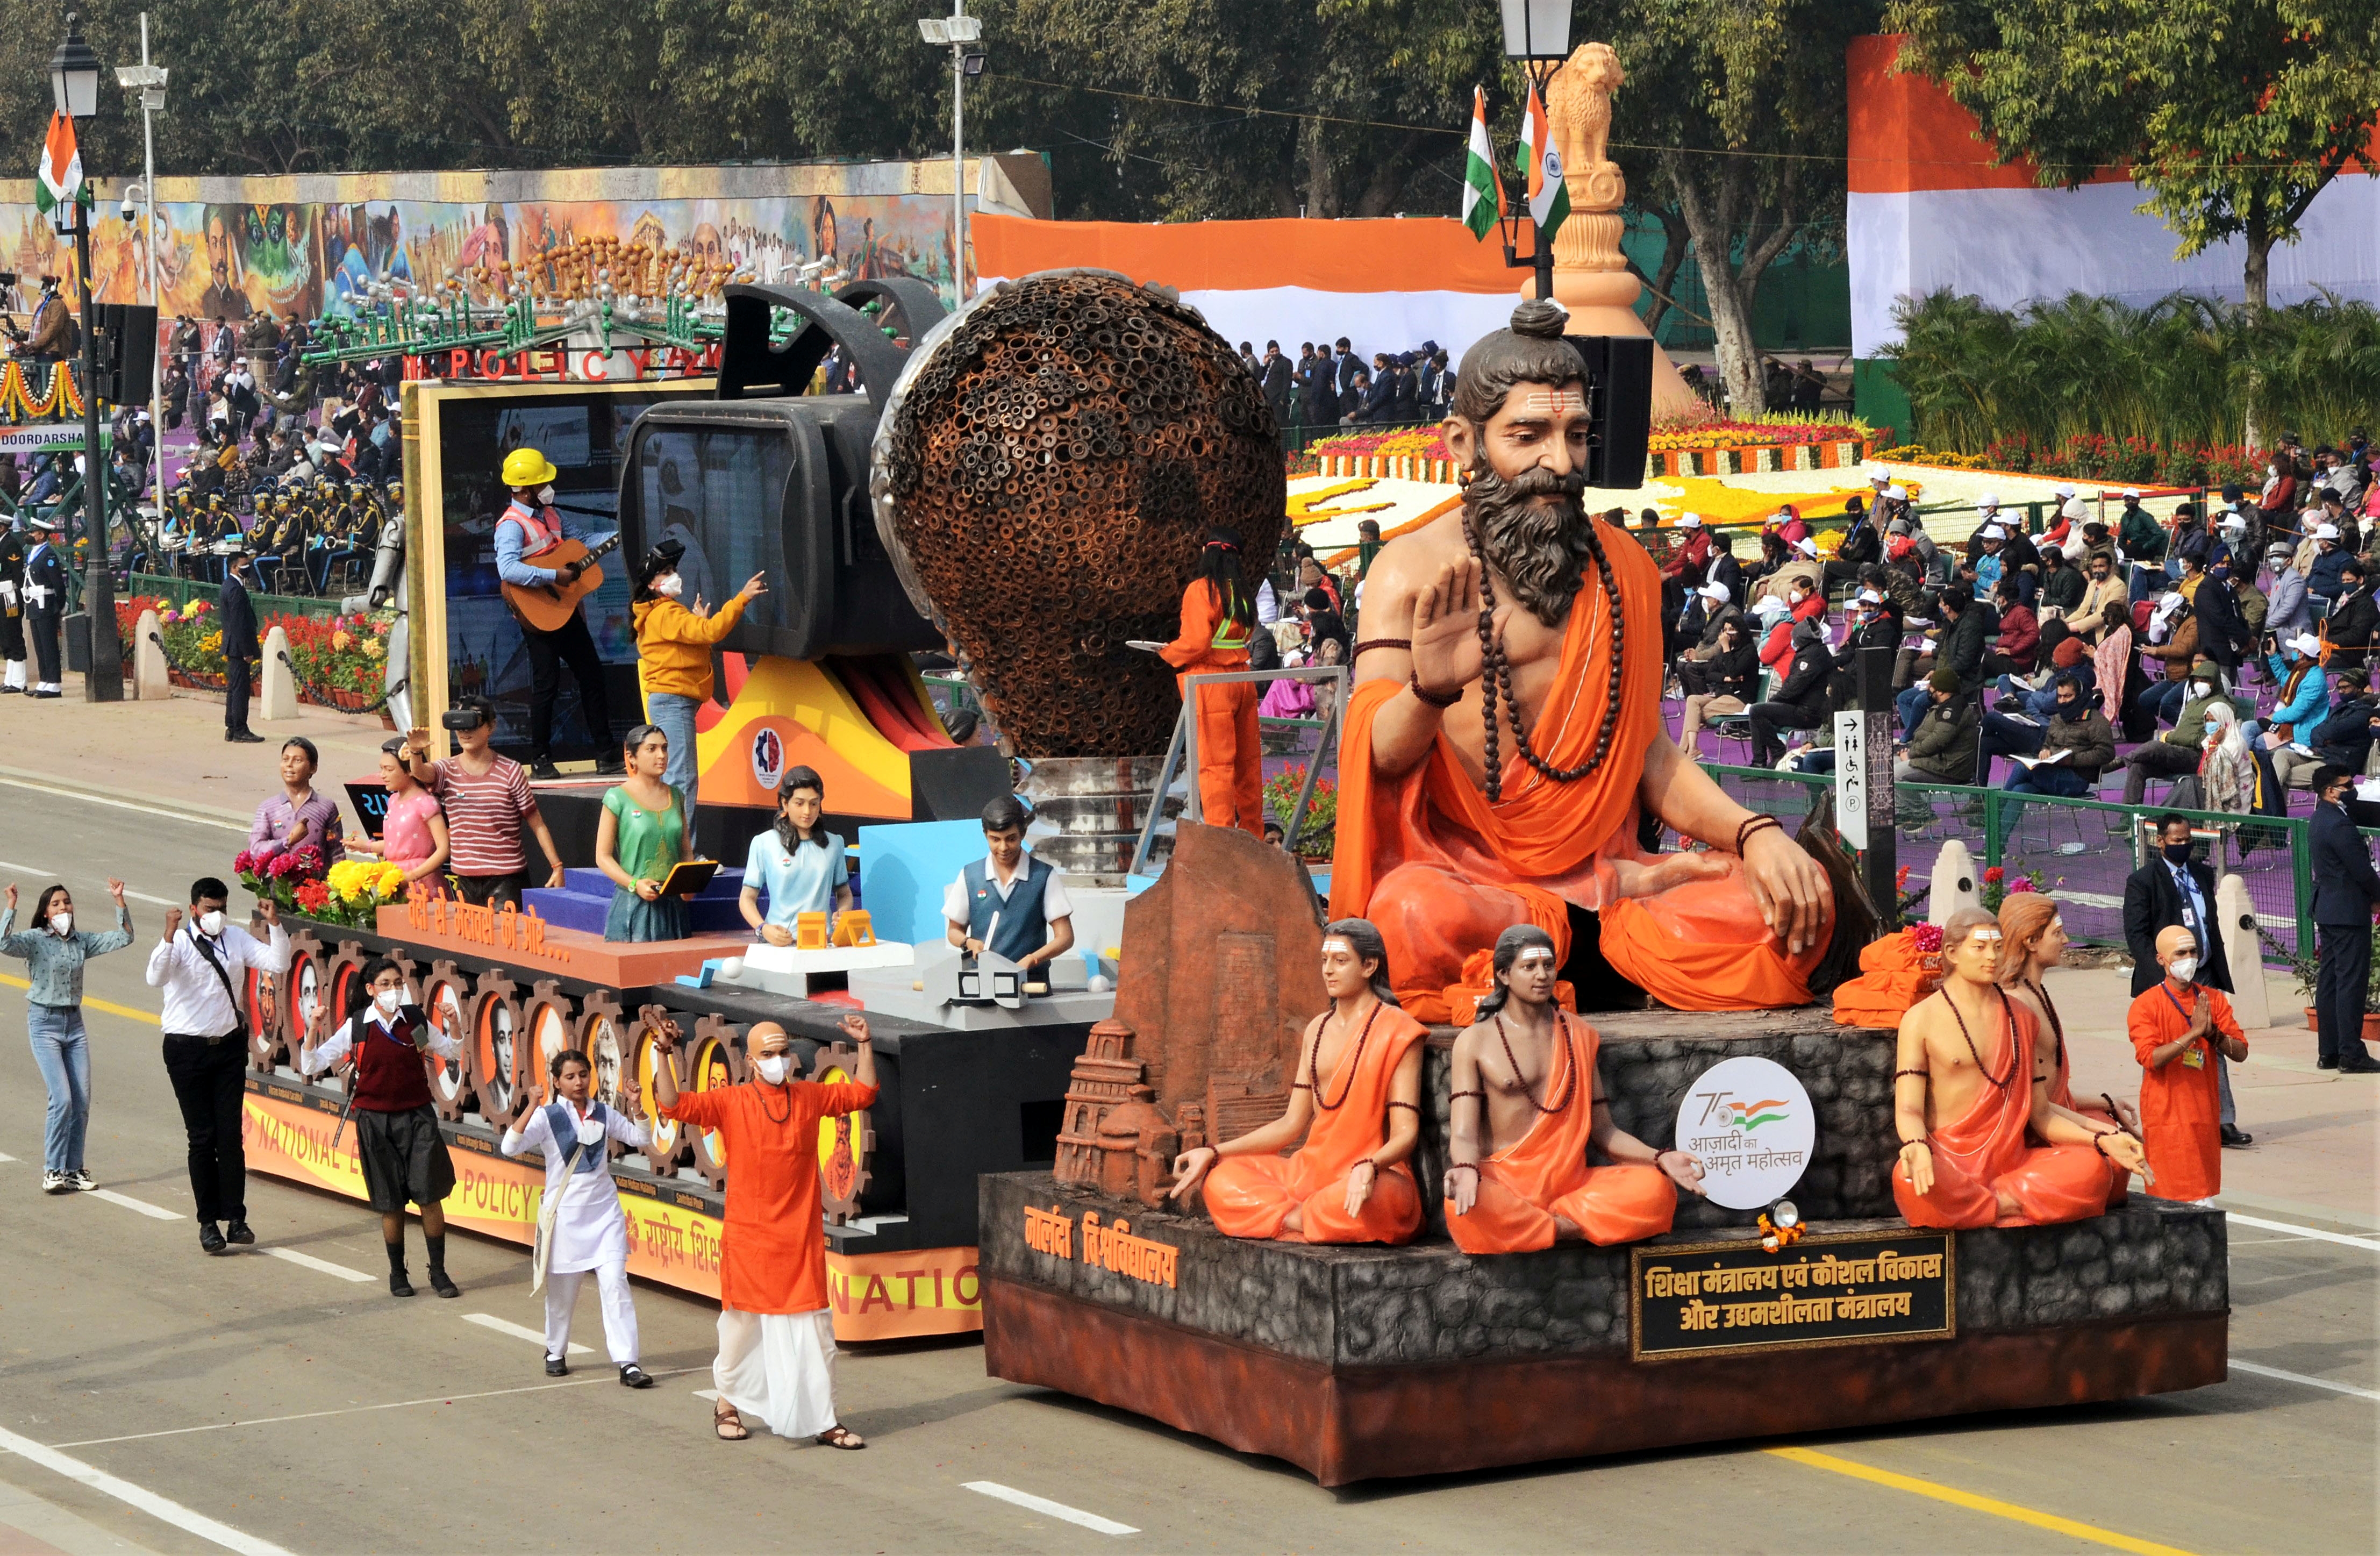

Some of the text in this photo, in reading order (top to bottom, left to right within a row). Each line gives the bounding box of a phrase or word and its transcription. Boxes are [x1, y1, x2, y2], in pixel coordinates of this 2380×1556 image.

[2, 433, 84, 445] DOORDARSHA
[433, 887, 447, 935] से
[499, 900, 518, 951] की
[259, 1115, 340, 1169] NATIONAL
[1688, 1130, 1757, 1155] आज़ादी का
[1705, 1148, 1804, 1176] अमृत महोत्सव
[463, 1168, 534, 1220] POLICY
[644, 1212, 721, 1275] राष्ट्रीय शिक्ष
[1024, 1205, 1179, 1288] नालंदा विश्वविद्यालय
[830, 1265, 982, 1315] NATIO
[1645, 1251, 1942, 1298] शिक्षा मंत्रालय एवं कौशल विकास
[1680, 1289, 1912, 1331] और उद्यमशीलता मंत्रालय
